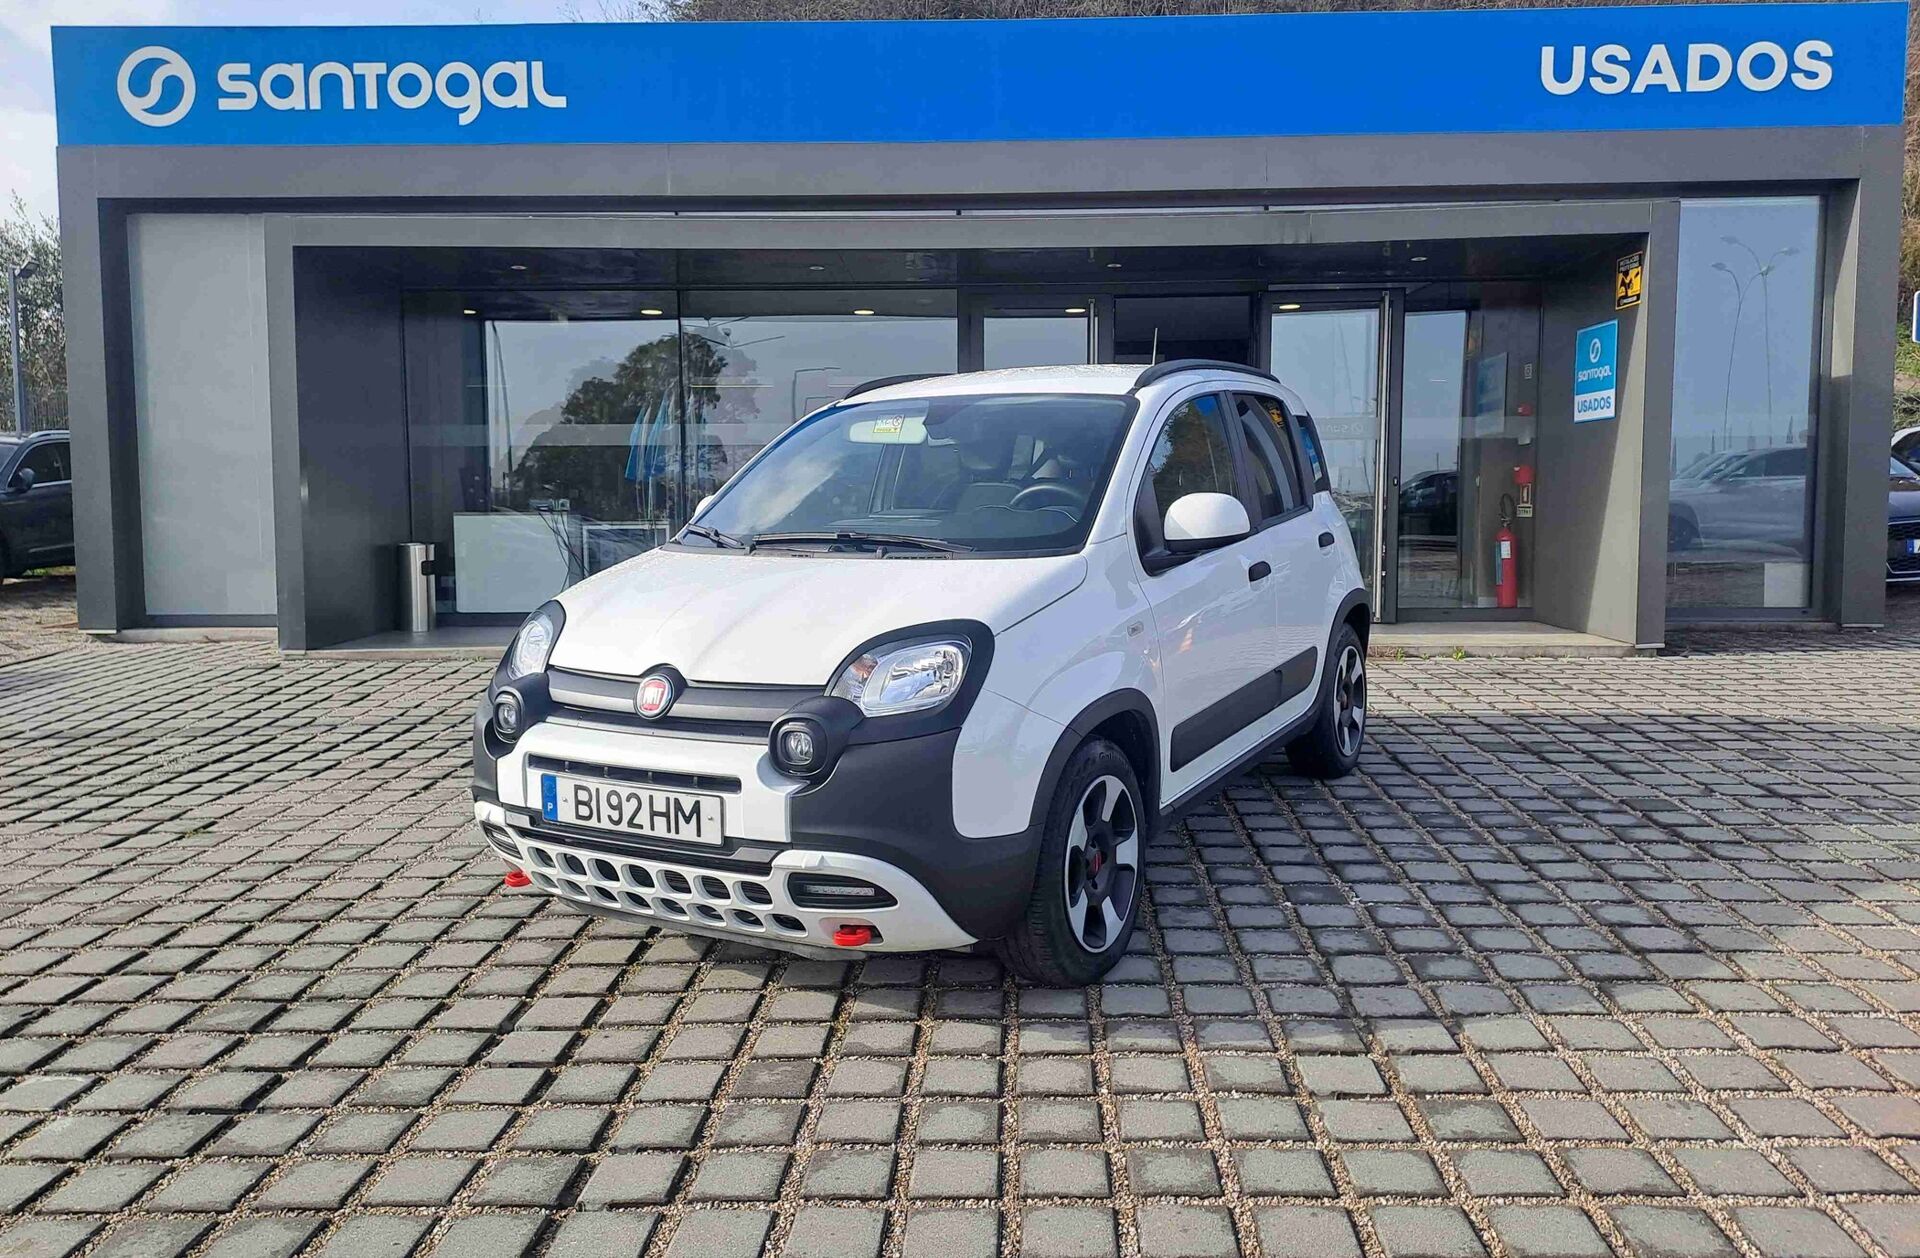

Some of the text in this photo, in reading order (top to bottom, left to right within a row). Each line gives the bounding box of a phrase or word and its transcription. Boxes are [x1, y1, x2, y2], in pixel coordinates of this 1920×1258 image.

[1540, 40, 1833, 95] USADOS
[1577, 396, 1612, 413] USADOS
[547, 802, 554, 812] P
